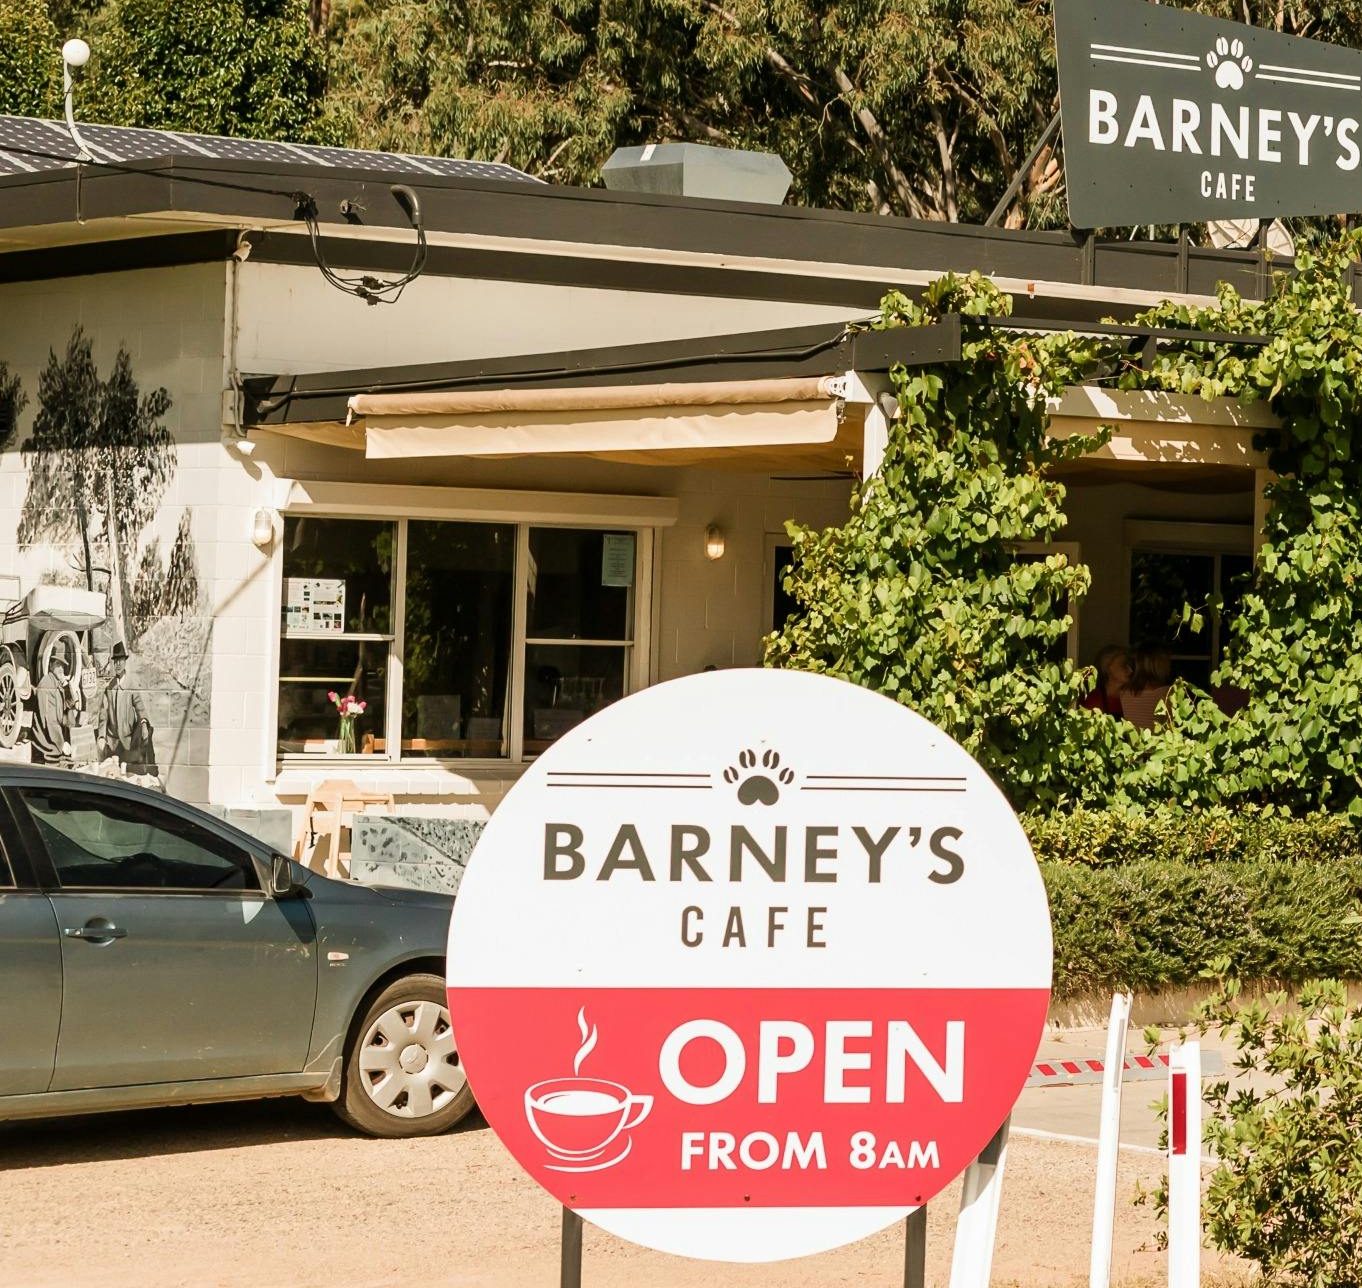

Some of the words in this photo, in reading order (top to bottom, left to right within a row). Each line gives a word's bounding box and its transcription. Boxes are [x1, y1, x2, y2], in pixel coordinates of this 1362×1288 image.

[1089, 89, 1361, 171] BARNEY'S
[1201, 171, 1256, 202] CAFE
[544, 823, 965, 885] BARNEY'S
[682, 906, 828, 948] CAFE
[659, 1020, 965, 1105] OPEN
[682, 1132, 827, 1170] FROM
